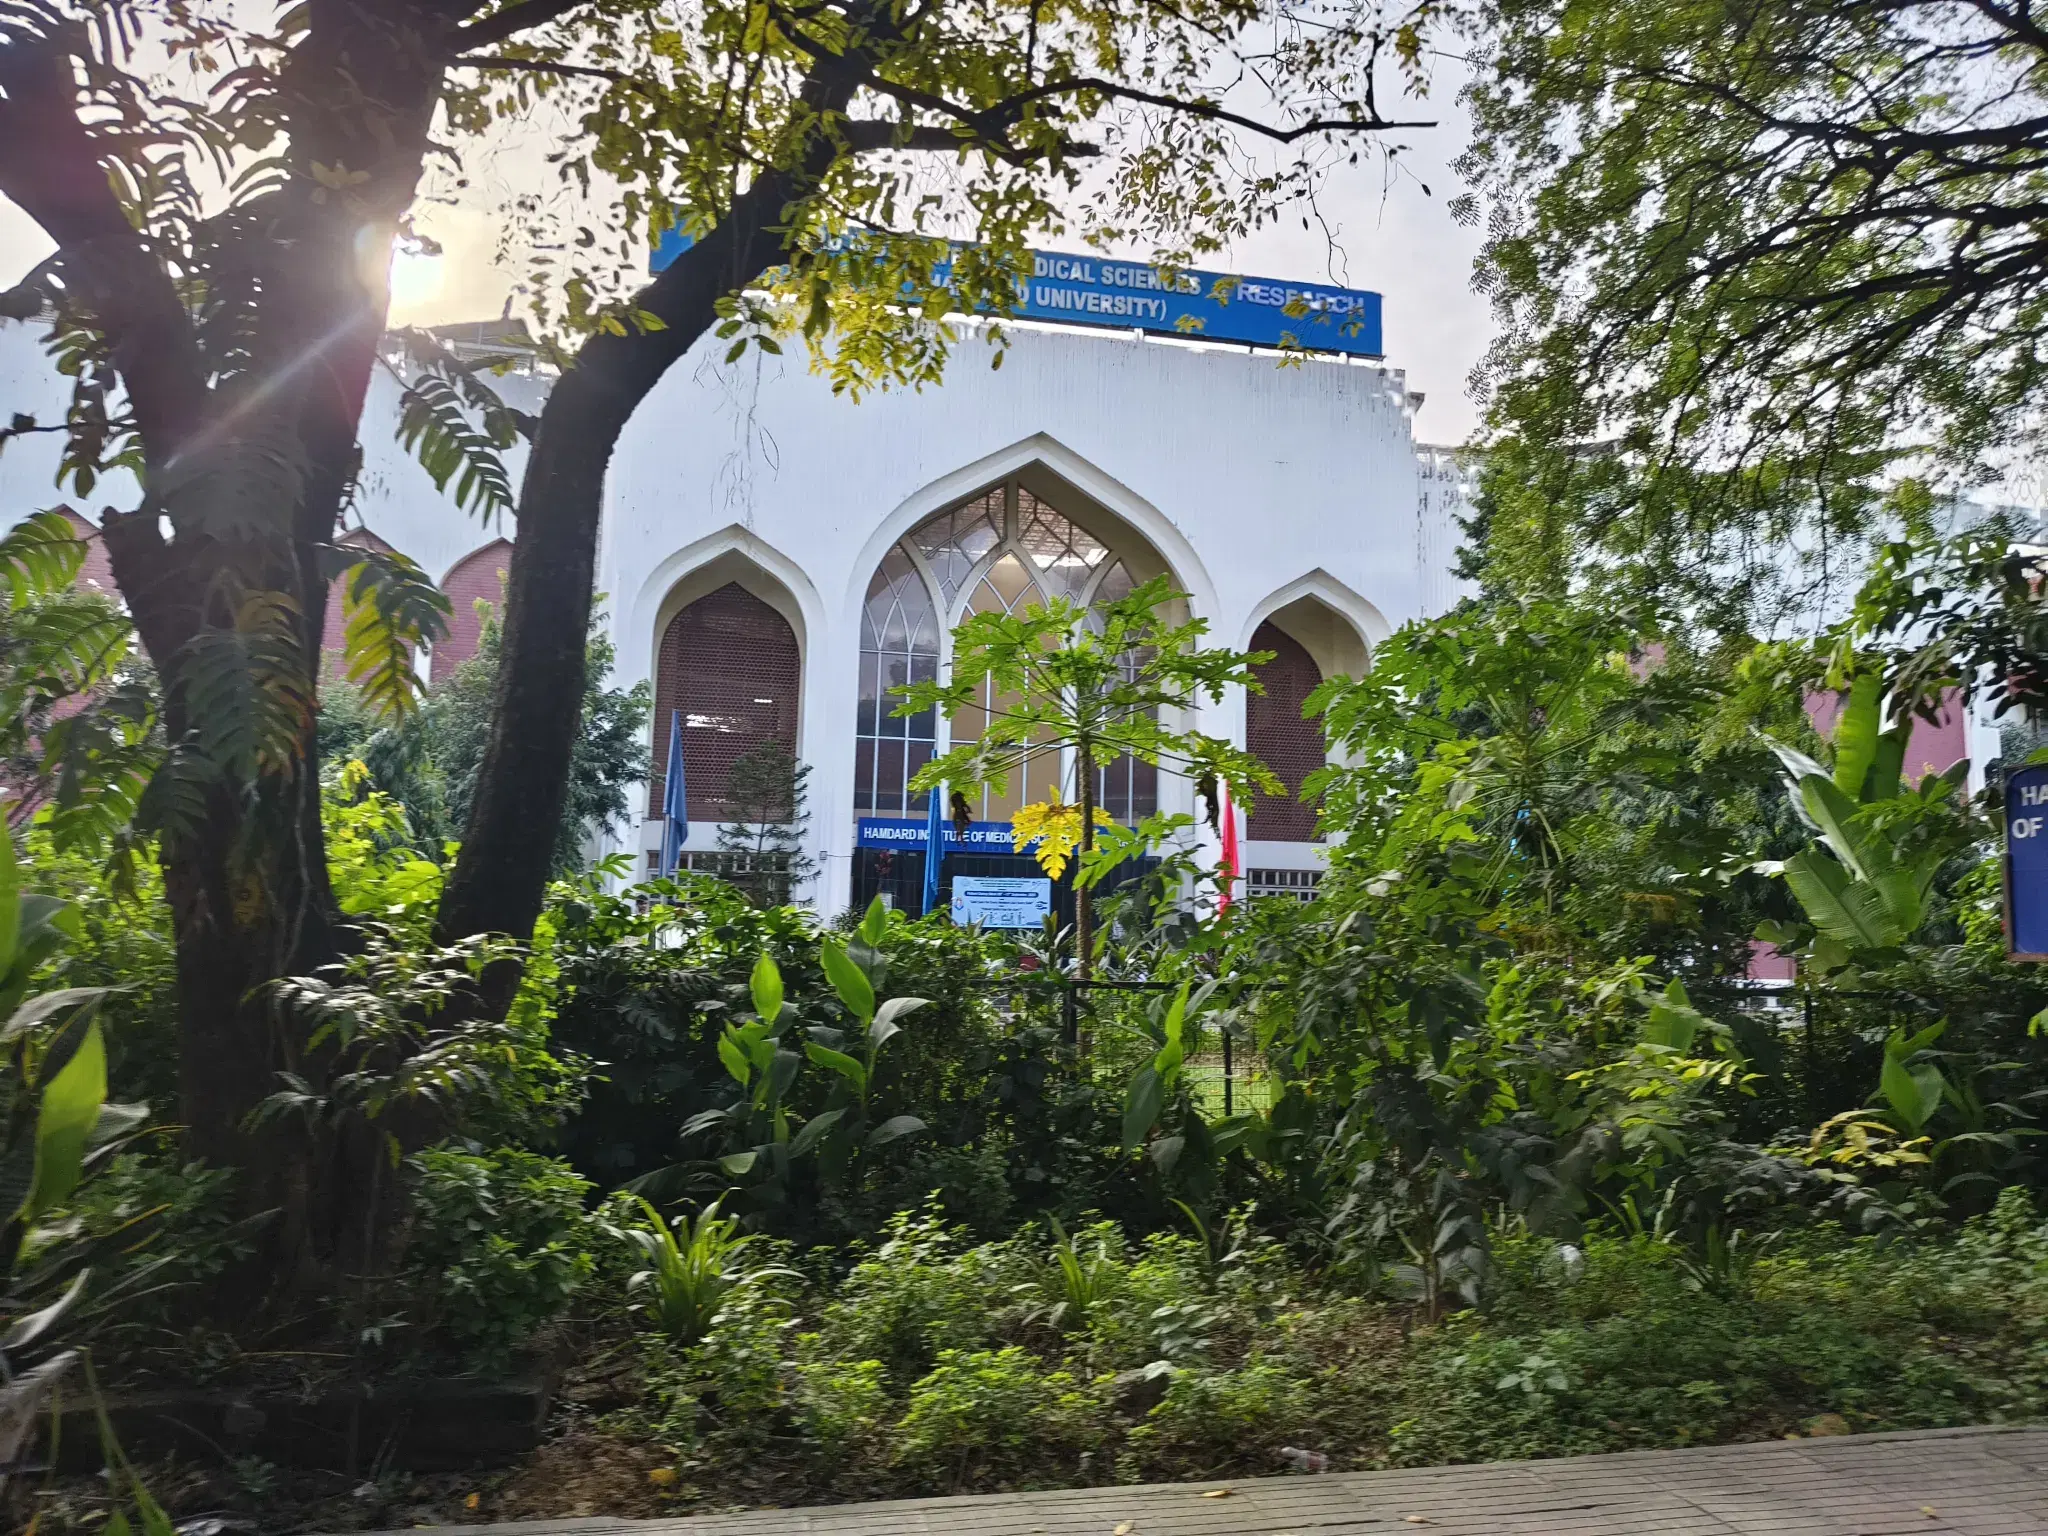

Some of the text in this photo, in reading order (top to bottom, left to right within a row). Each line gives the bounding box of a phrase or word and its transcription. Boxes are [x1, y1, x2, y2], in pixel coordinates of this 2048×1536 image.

[1015, 255, 1095, 283] DICAL
[1035, 286, 1167, 322] UNIVERSITY)
[864, 827, 916, 840] HAMDARD
[971, 831, 985, 842] OF
[2012, 816, 2043, 839] OF
